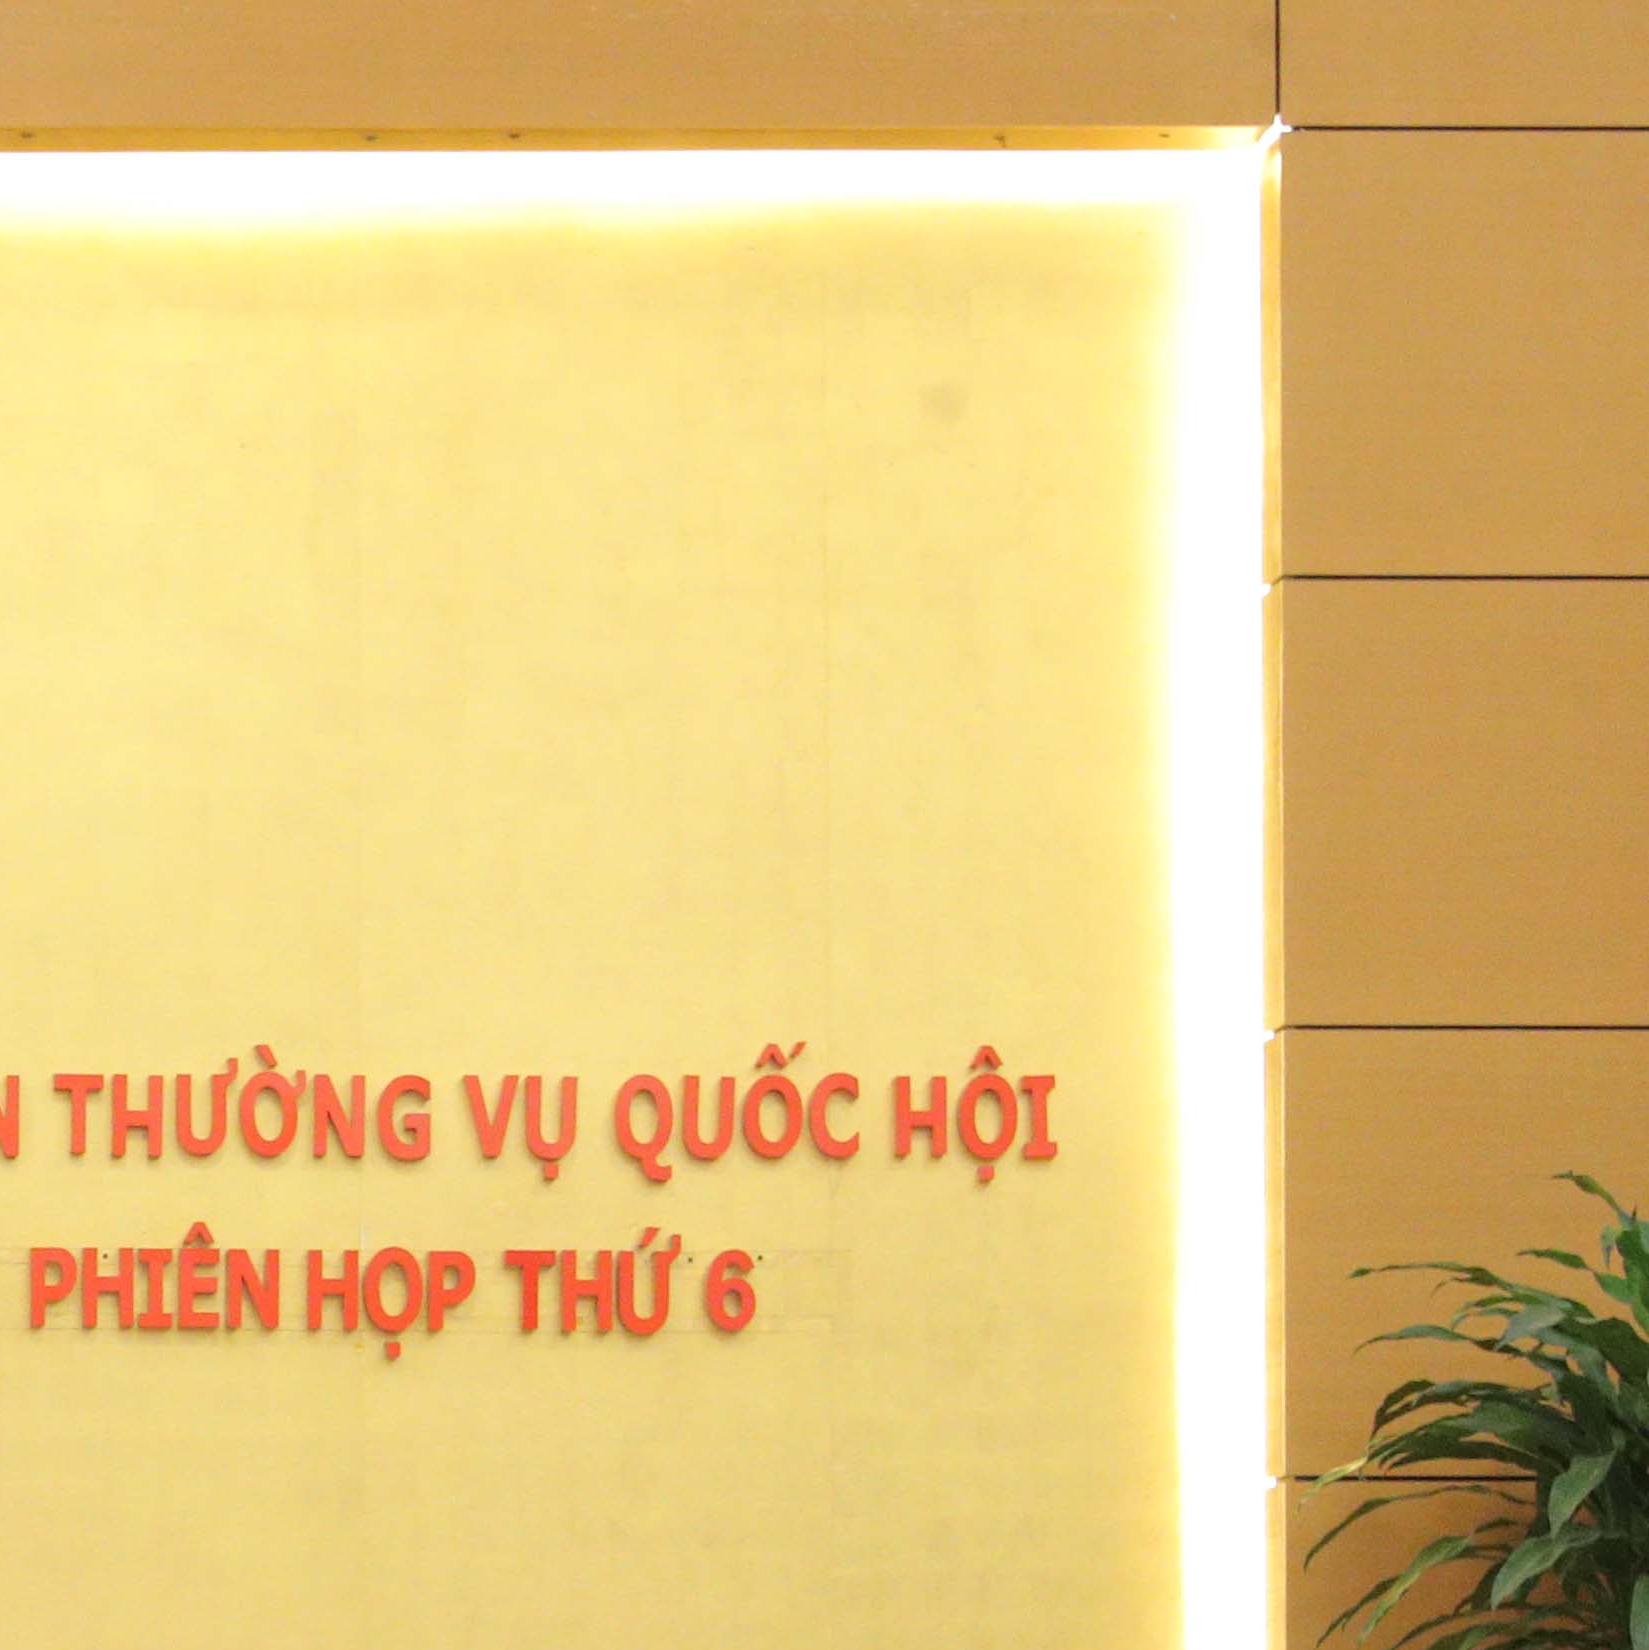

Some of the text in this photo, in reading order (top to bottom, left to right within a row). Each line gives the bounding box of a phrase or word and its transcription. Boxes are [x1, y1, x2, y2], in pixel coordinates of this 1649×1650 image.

[54, 1044, 432, 1161] THƯỜNG
[465, 1074, 577, 1180] VỤ
[614, 1043, 860, 1182] QUỐC
[894, 1045, 1058, 1182] HỘI
[30, 1222, 757, 1360] PHIÊN HỌP THỨ 6
